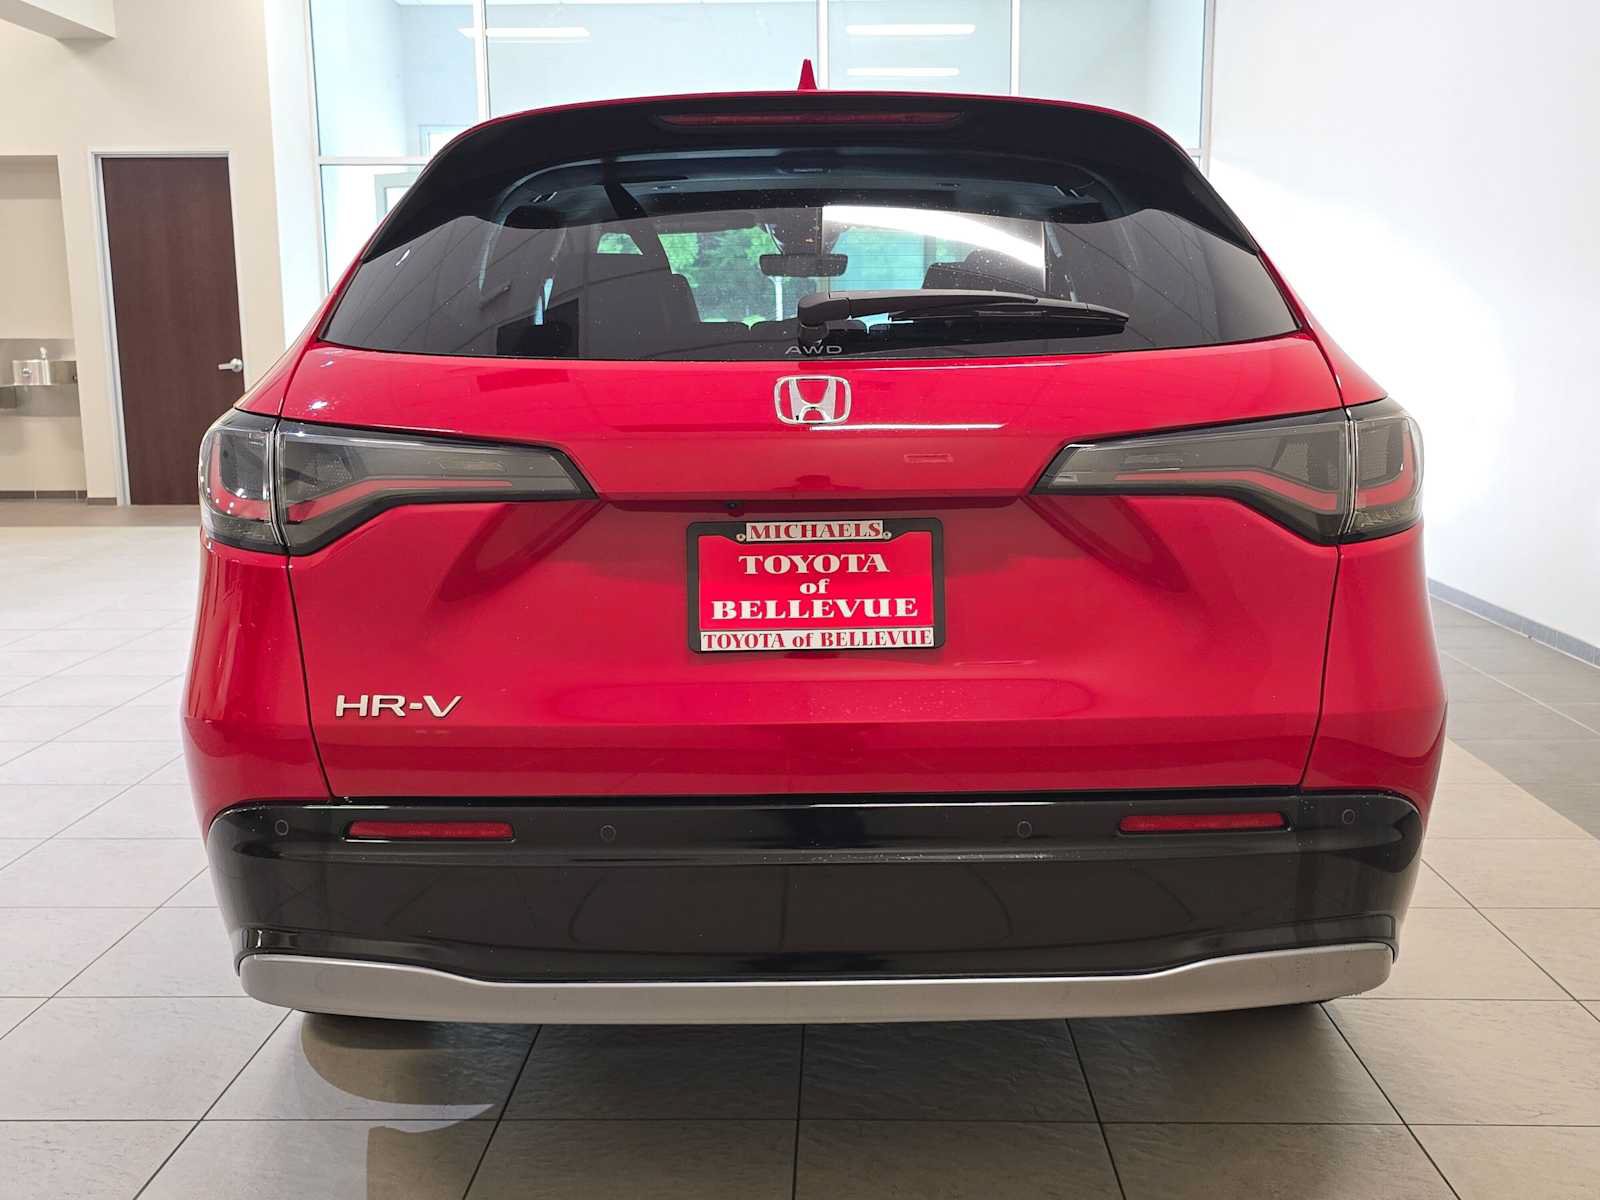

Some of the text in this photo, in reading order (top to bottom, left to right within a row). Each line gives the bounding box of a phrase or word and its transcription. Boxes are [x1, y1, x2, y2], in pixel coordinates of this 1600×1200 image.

[785, 345, 843, 355] AWD
[750, 522, 881, 539] MICHAELS
[739, 553, 890, 575] TOYOTA
[800, 578, 830, 595] of
[711, 597, 918, 620] BELLEVUE
[703, 629, 932, 649] TOYOTA of BELLEVUE
[336, 694, 462, 718] HR-V
